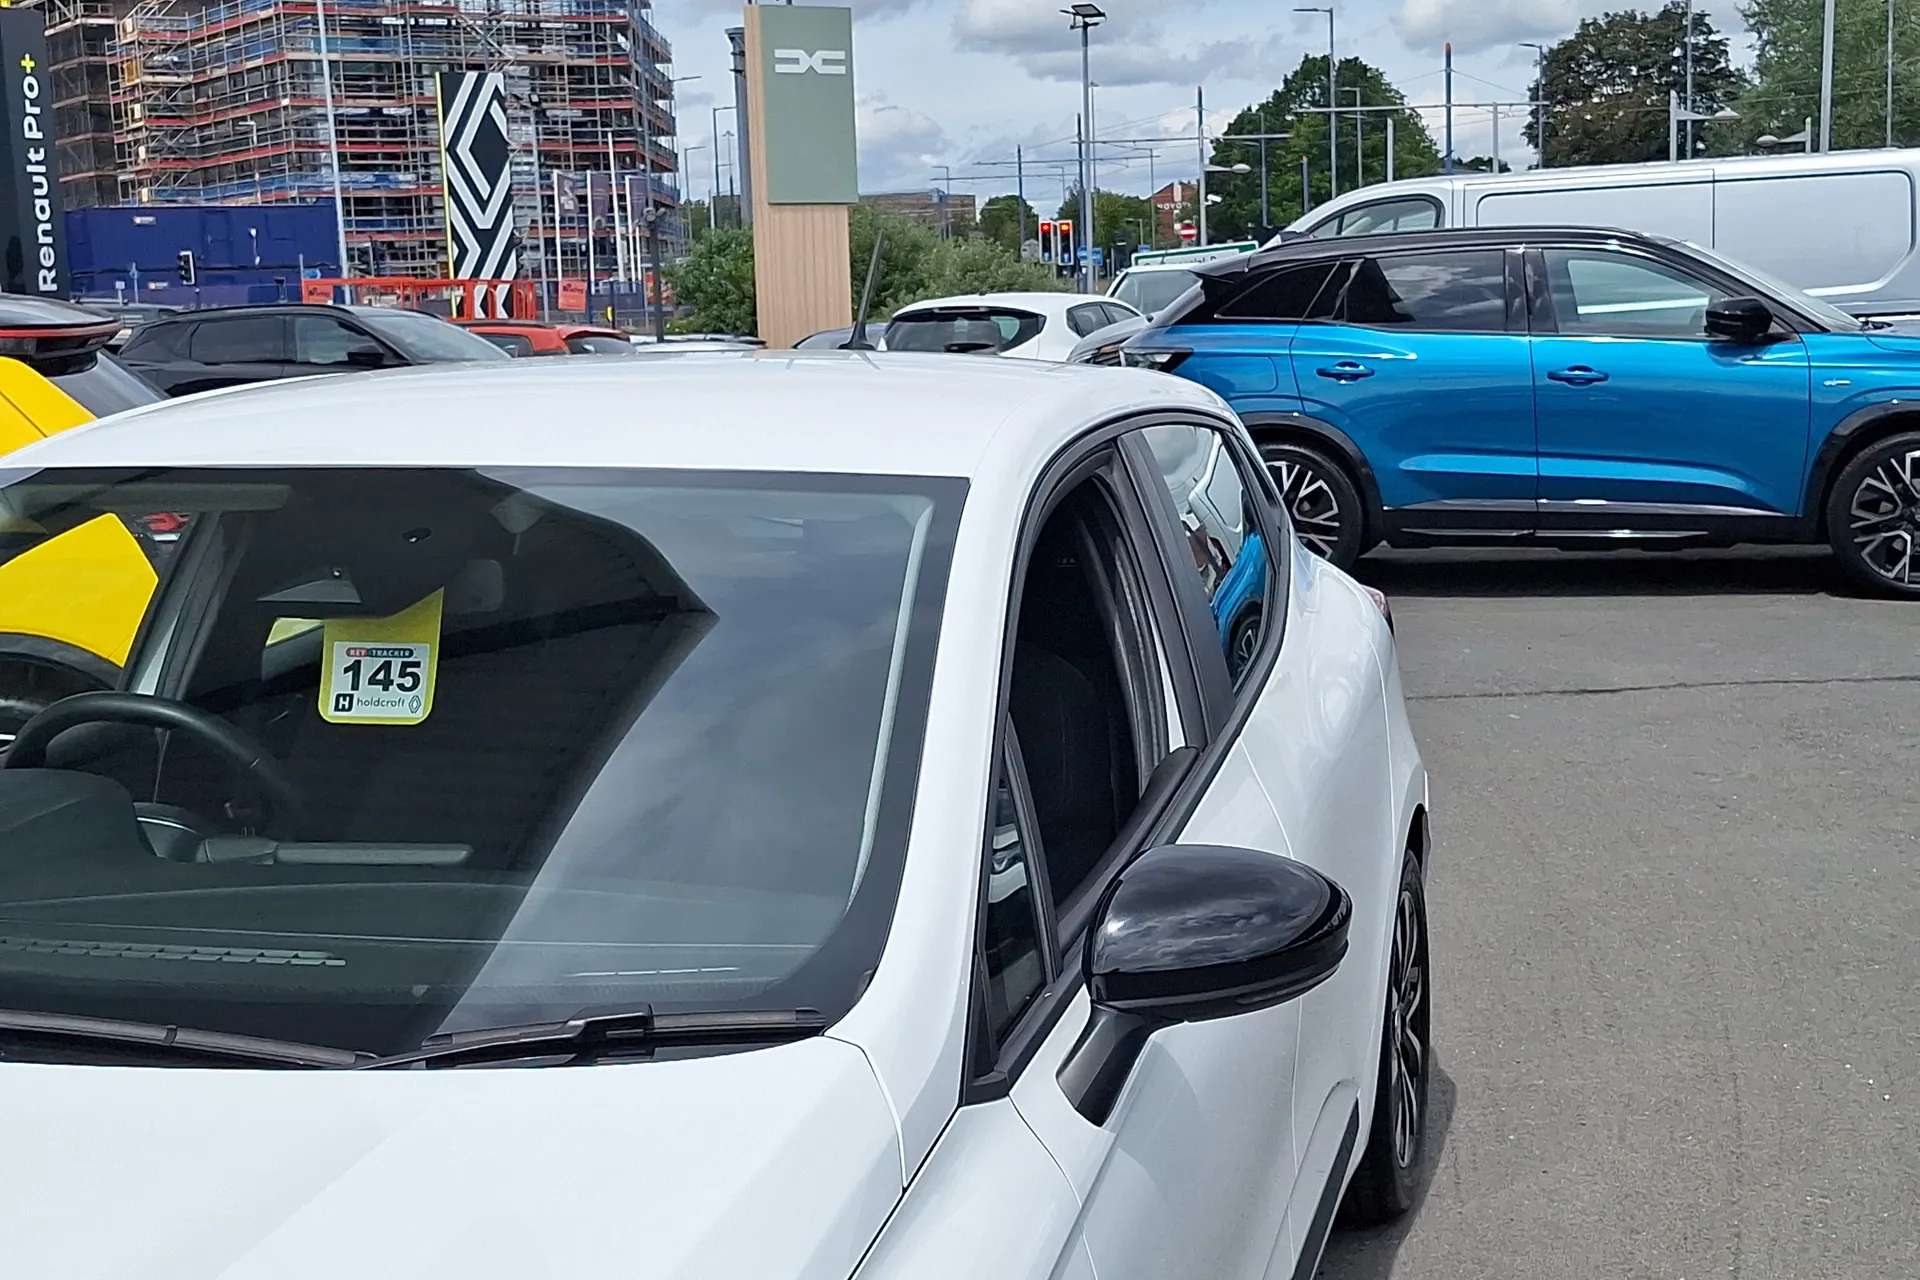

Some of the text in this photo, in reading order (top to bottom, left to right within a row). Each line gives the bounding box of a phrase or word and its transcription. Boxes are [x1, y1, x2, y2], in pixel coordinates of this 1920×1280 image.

[26, 147, 58, 292] Renault
[349, 648, 411, 657] KEY TRACKER
[343, 659, 421, 692] 145
[356, 697, 405, 708] holdcroft
